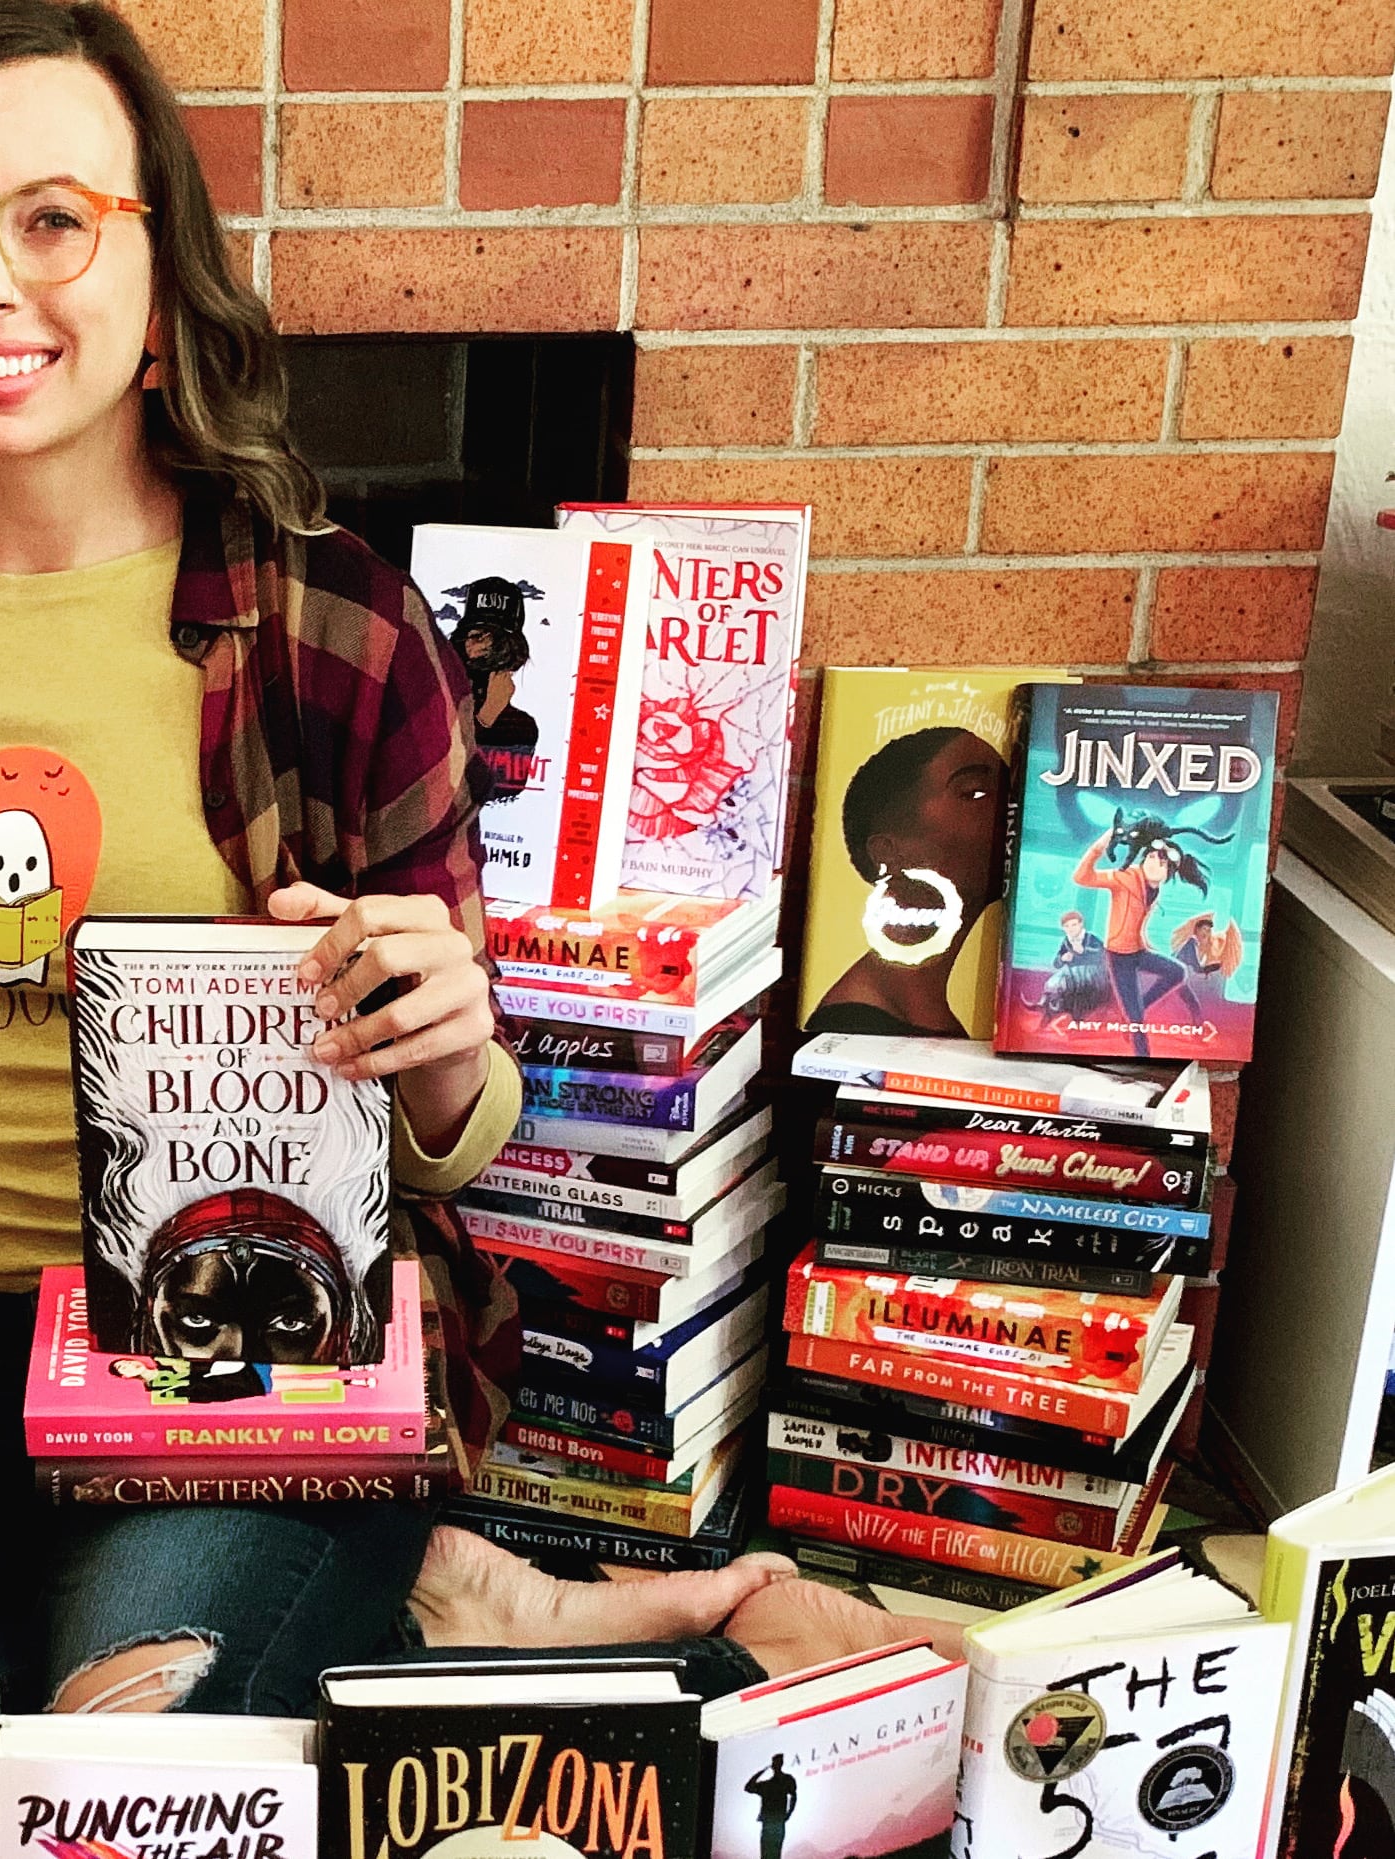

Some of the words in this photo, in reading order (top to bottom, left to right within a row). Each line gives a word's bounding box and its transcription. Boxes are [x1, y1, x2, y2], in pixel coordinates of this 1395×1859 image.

[653, 549, 784, 602] NTERS
[698, 603, 733, 624] OF
[874, 700, 937, 744] TIFFANY
[1042, 729, 1262, 797] JINXED
[489, 847, 531, 868] HMED
[629, 860, 658, 872] BAIN
[661, 864, 714, 879] MURPHY
[166, 963, 191, 972] NEW
[196, 963, 226, 972] YORK
[232, 963, 267, 972] TIMES
[492, 932, 630, 970] UMINAE
[130, 977, 195, 995] TOMI
[207, 977, 316, 996] ADEYEM
[547, 1000, 586, 1020] YOU
[593, 1004, 651, 1027] FIRST
[1067, 1019, 1102, 1032] AMY
[1107, 1021, 1205, 1037] McCULLOCH
[216, 1048, 252, 1069] OF
[146, 1070, 328, 1115] BLOOD
[559, 1082, 656, 1110] STRONG
[800, 1064, 849, 1079] SCHMIDT
[889, 1075, 975, 1100] orbiting
[982, 1087, 1057, 1112] jupiter
[212, 1116, 262, 1138] AND
[965, 1112, 1025, 1133] Dear
[1028, 1116, 1102, 1142] Martin
[168, 1135, 312, 1187] BONE
[868, 1136, 951, 1164] STAND
[994, 1142, 1059, 1178] Yumi
[567, 1187, 624, 1208] GLASS
[857, 1182, 903, 1198] HICKS
[542, 1201, 587, 1223] TRAIL
[1020, 1198, 1119, 1223] NAMELESS
[1123, 1209, 1170, 1230] CITY
[495, 1221, 543, 1244] SAVE
[549, 1233, 589, 1253] YOU
[593, 1242, 648, 1267] FIRST
[990, 1259, 1036, 1280] IRON
[1041, 1262, 1088, 1285] TRIAL
[67, 1287, 88, 1333] YOON
[867, 1299, 1073, 1355] ILLUMINAE
[60, 1337, 90, 1387] DAVID
[849, 1353, 894, 1377] FAR
[903, 1367, 954, 1389] FROM
[961, 1379, 996, 1397] THE
[1005, 1386, 1069, 1415] TREE
[45, 1433, 88, 1444] DAVID
[93, 1432, 134, 1443] YOON
[165, 1426, 284, 1446] FRANKLY
[292, 1430, 315, 1442] IN
[322, 1427, 391, 1443] LOVE
[905, 1440, 1066, 1490] INTERNMENT
[114, 1475, 292, 1503] CEMETERY
[302, 1474, 395, 1501] BOYS
[497, 1478, 551, 1506] FINCH
[831, 1461, 951, 1515] DRY
[494, 1522, 591, 1551] KINGDOM
[614, 1540, 679, 1565] BACK
[844, 1508, 899, 1543] WITH
[900, 1526, 927, 1547] THE
[931, 1526, 982, 1558] FIRE
[979, 1544, 997, 1560] ON
[1001, 1541, 1075, 1586] HIGH
[791, 1734, 861, 1767] ALAN
[876, 1699, 955, 1740] GRATZ
[341, 1734, 665, 1859] LOBIZONA
[18, 1787, 284, 1846] PUNCHING
